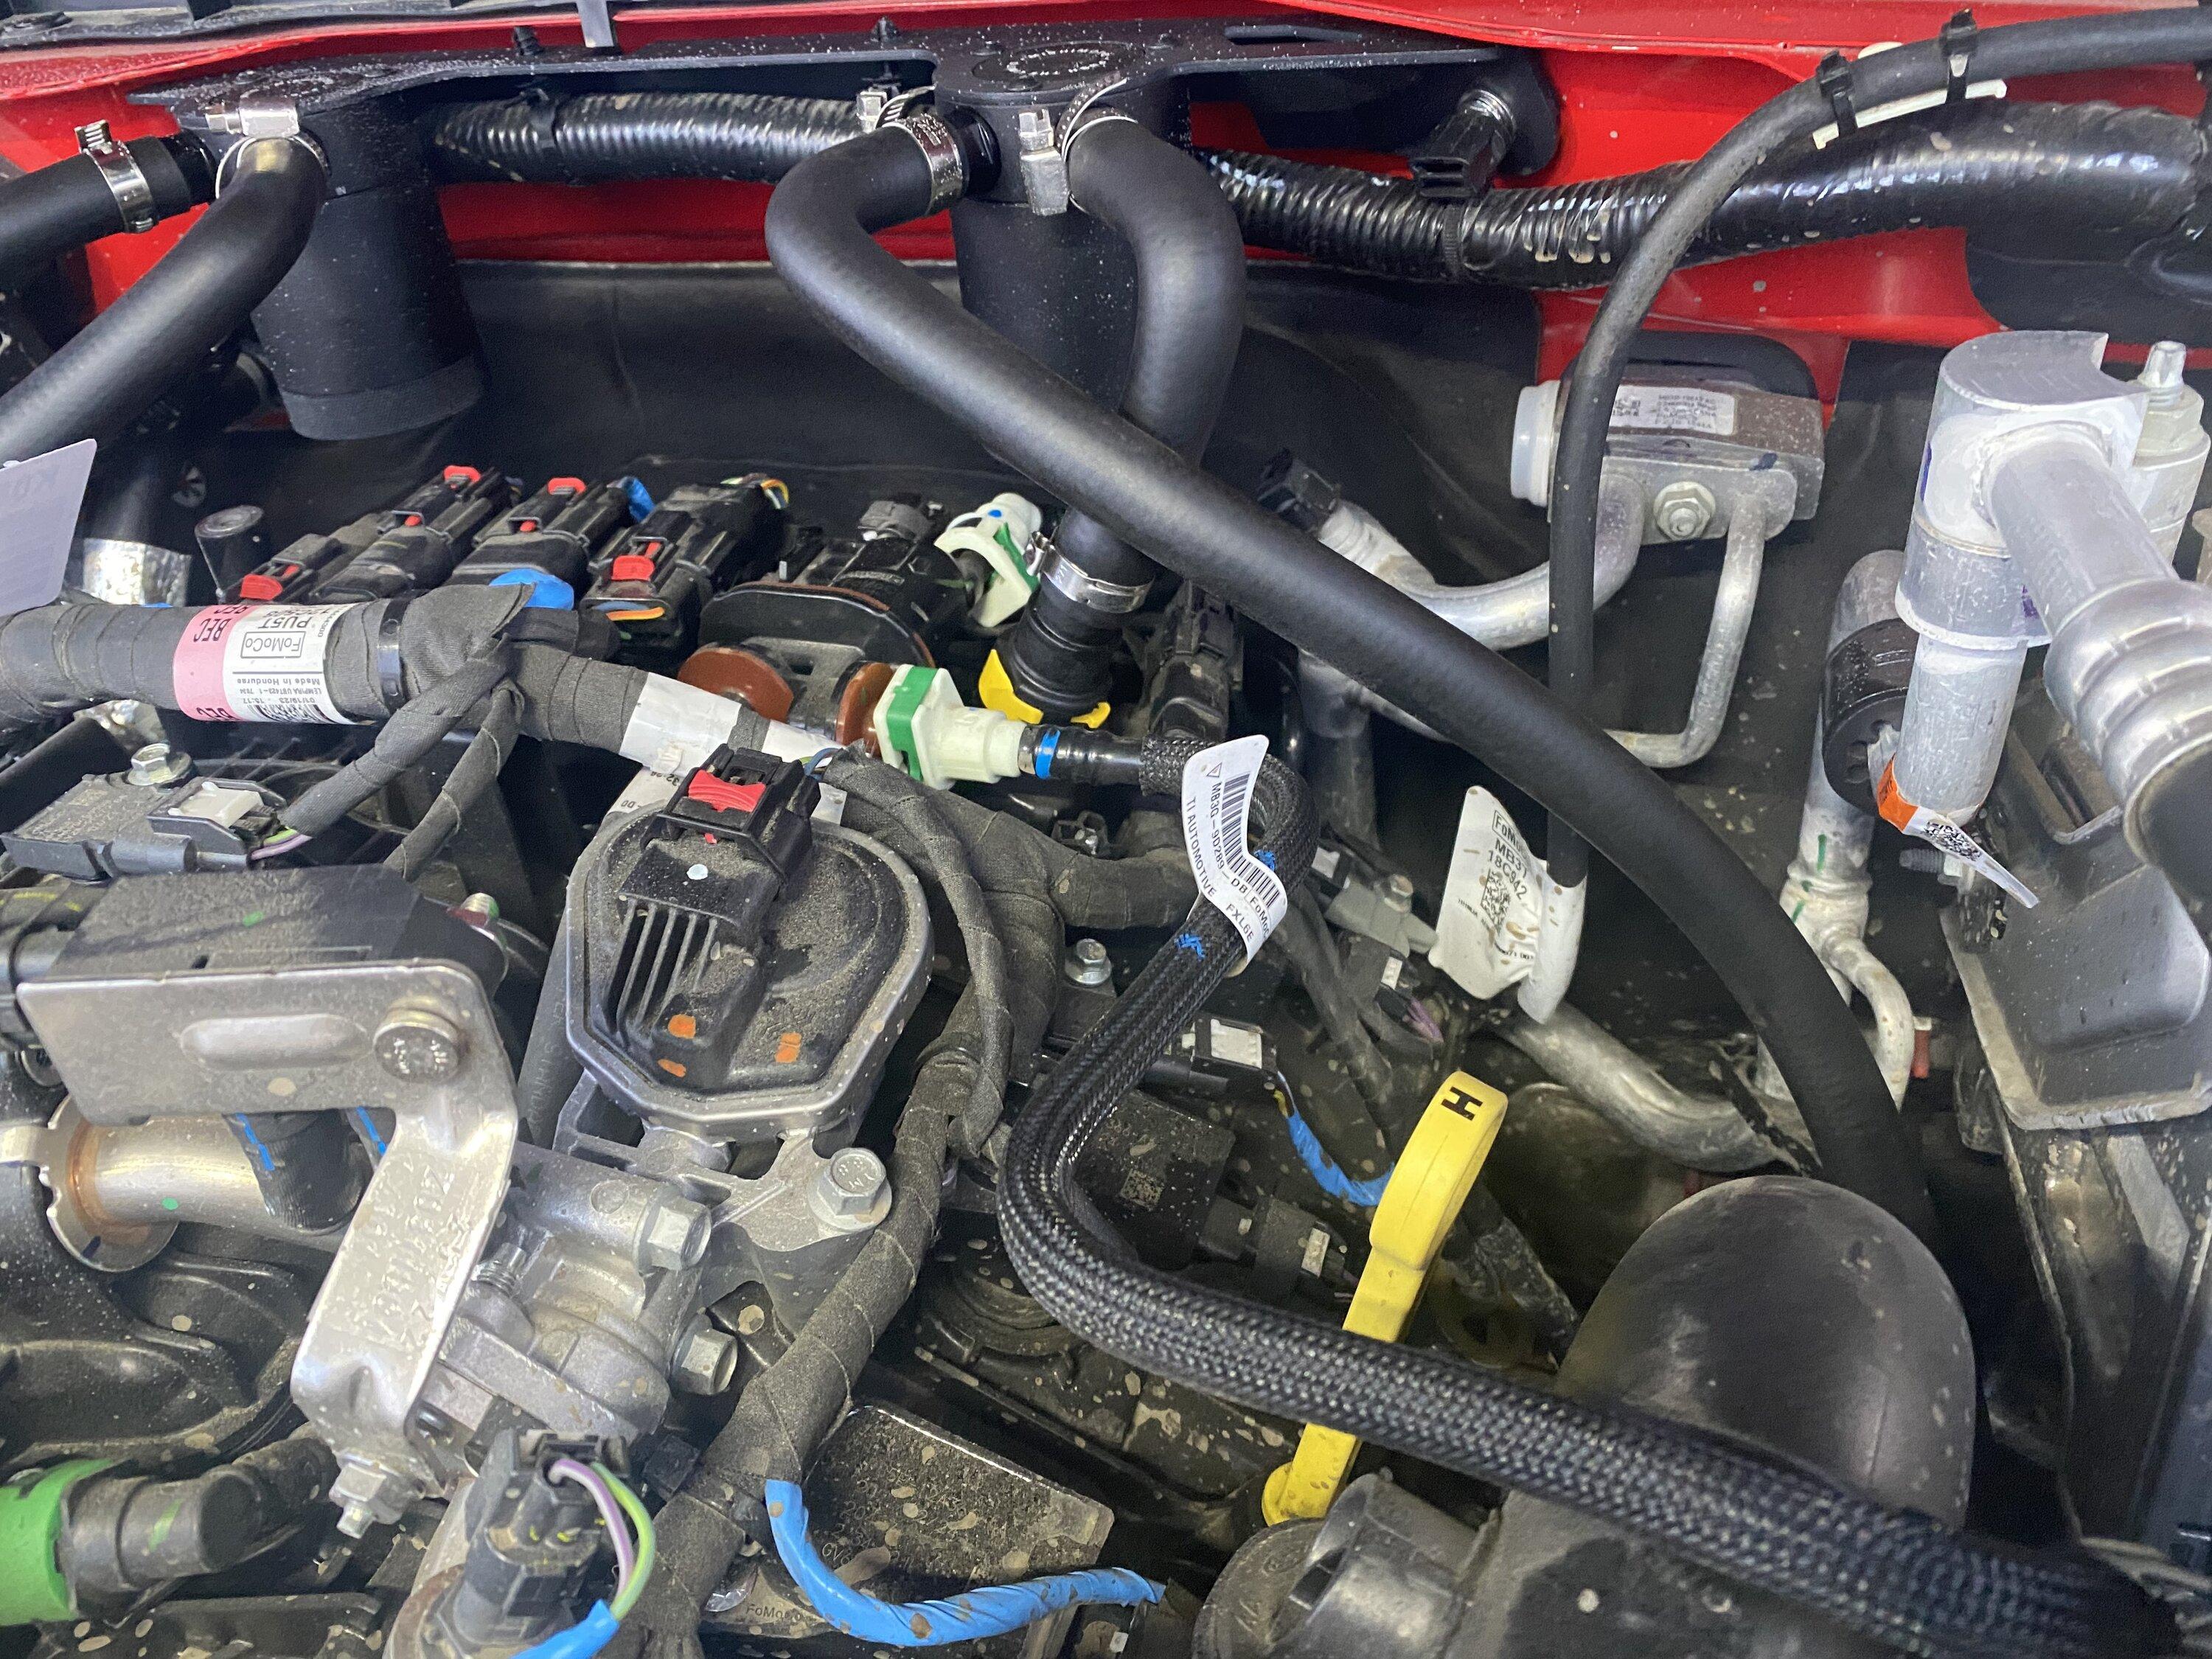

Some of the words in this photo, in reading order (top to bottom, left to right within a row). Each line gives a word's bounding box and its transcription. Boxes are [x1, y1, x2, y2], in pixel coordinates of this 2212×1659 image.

[192, 618, 232, 642] BEC
[245, 637, 302, 652] FoMoCo
[1187, 815, 1217, 897] AUTOMOTIVE
[1487, 849, 1528, 900] 18C942
[1249, 897, 1270, 941] FoMoC
[1441, 1086, 1484, 1121] H
